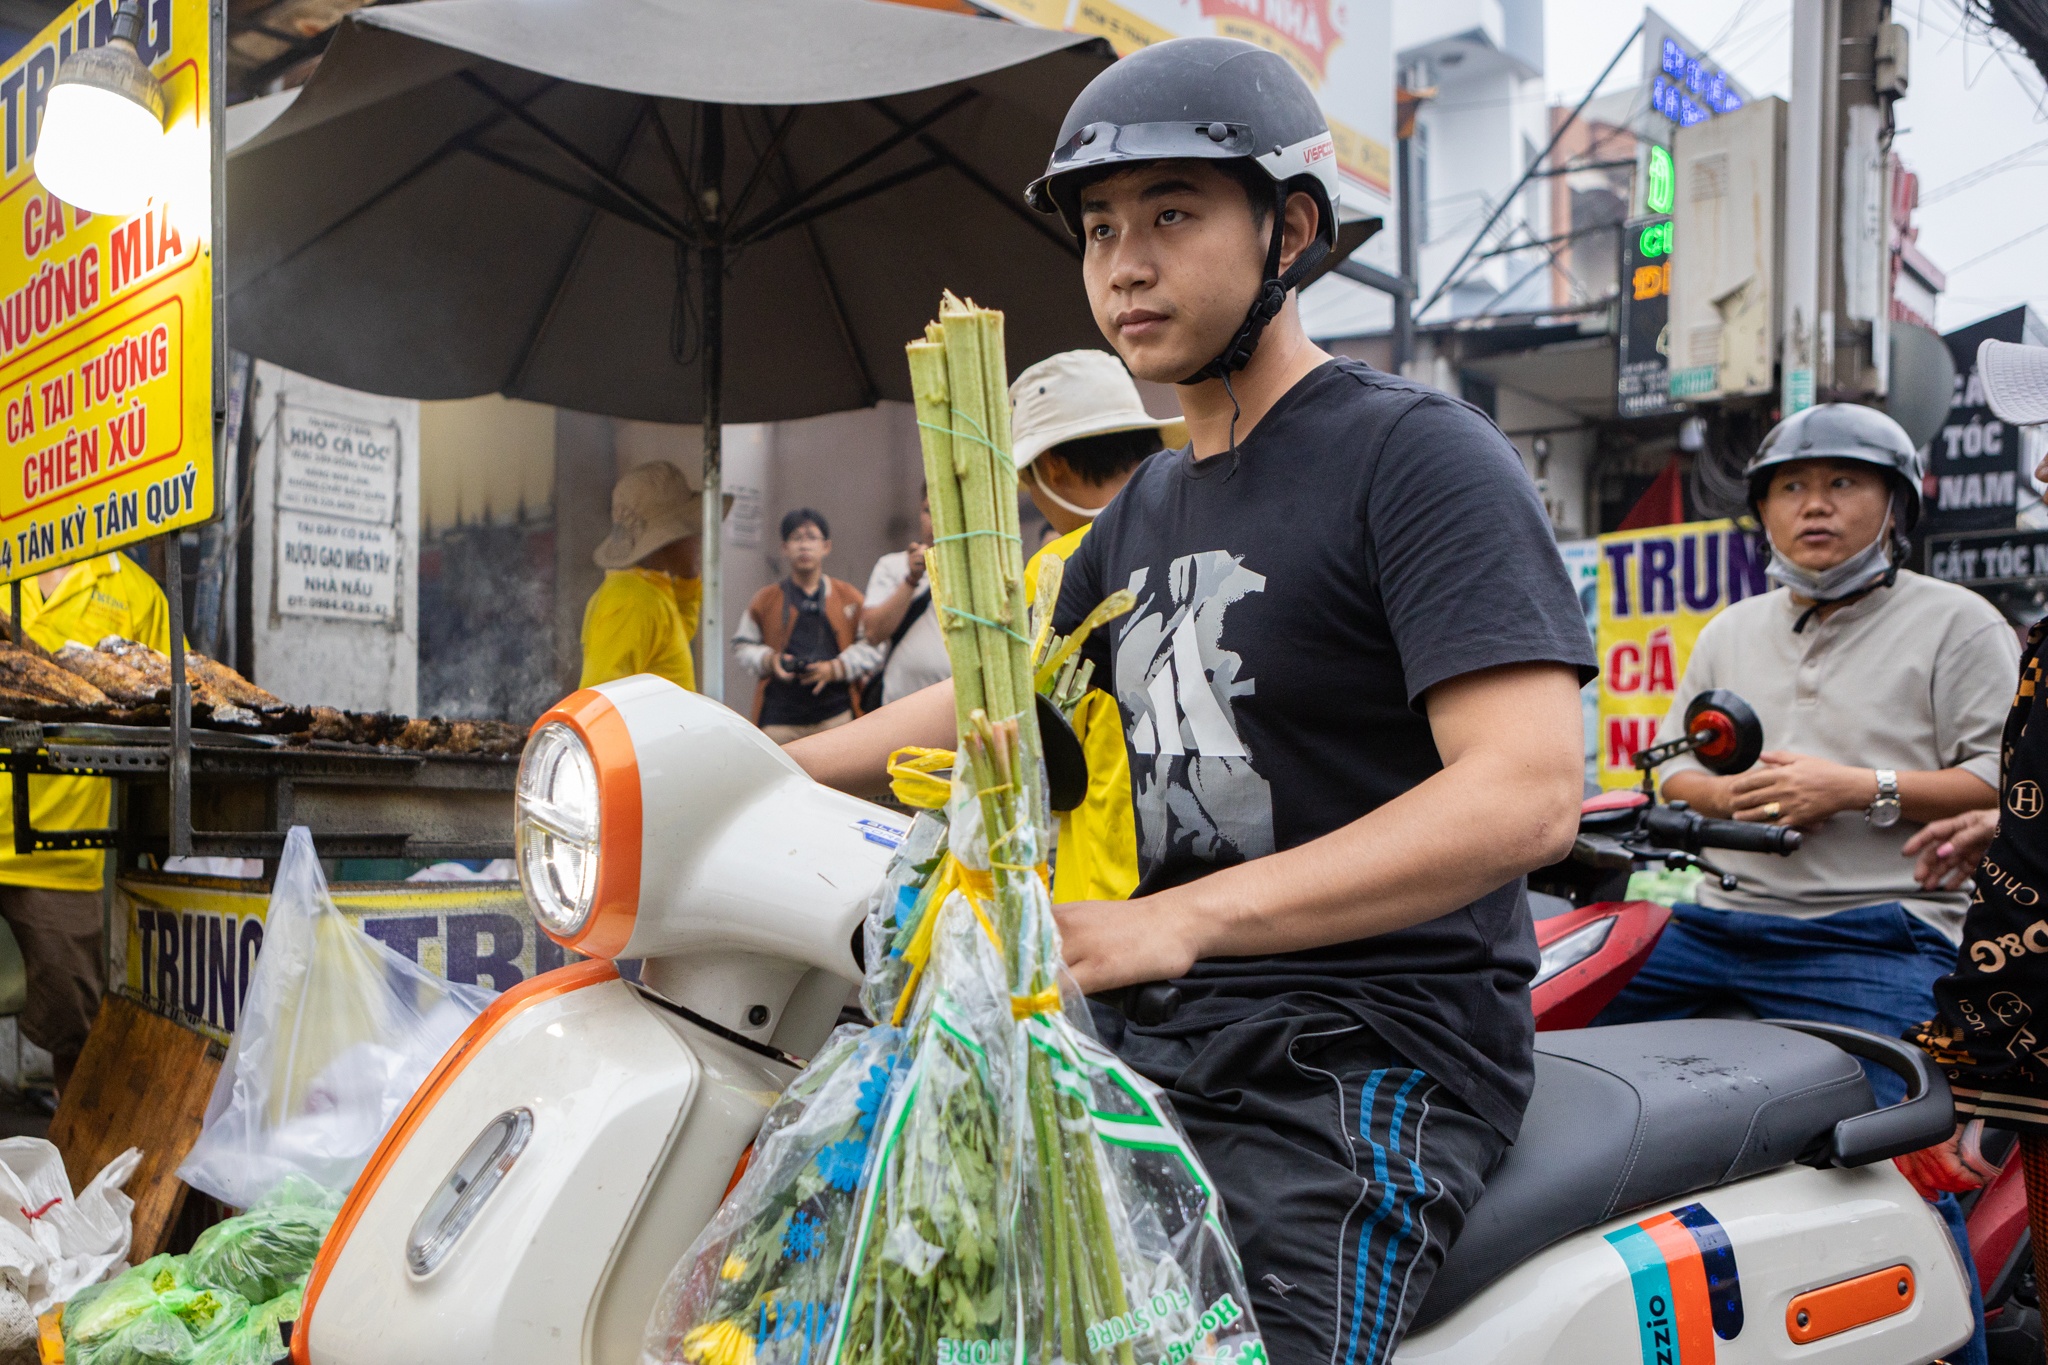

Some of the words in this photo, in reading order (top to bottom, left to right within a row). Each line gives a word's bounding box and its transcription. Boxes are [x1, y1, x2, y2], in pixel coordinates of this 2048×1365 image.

[7, 384, 35, 443] CÁ
[41, 373, 73, 427] TAI
[81, 326, 167, 409] TƯỢNG
[24, 427, 98, 500] CHIÊN
[108, 400, 146, 467] XÙ
[1943, 414, 2004, 460] TÓC
[18, 521, 54, 564] TÂN
[61, 504, 86, 550] KỲ
[94, 492, 138, 538] TÂN
[147, 465, 197, 523] QUÝ
[1938, 470, 2017, 510] NAM
[1604, 532, 1770, 617] TRUN
[1982, 539, 2031, 579] TÓC
[1610, 627, 1674, 692] CÁ
[1088, 1308, 1150, 1351] STORE
